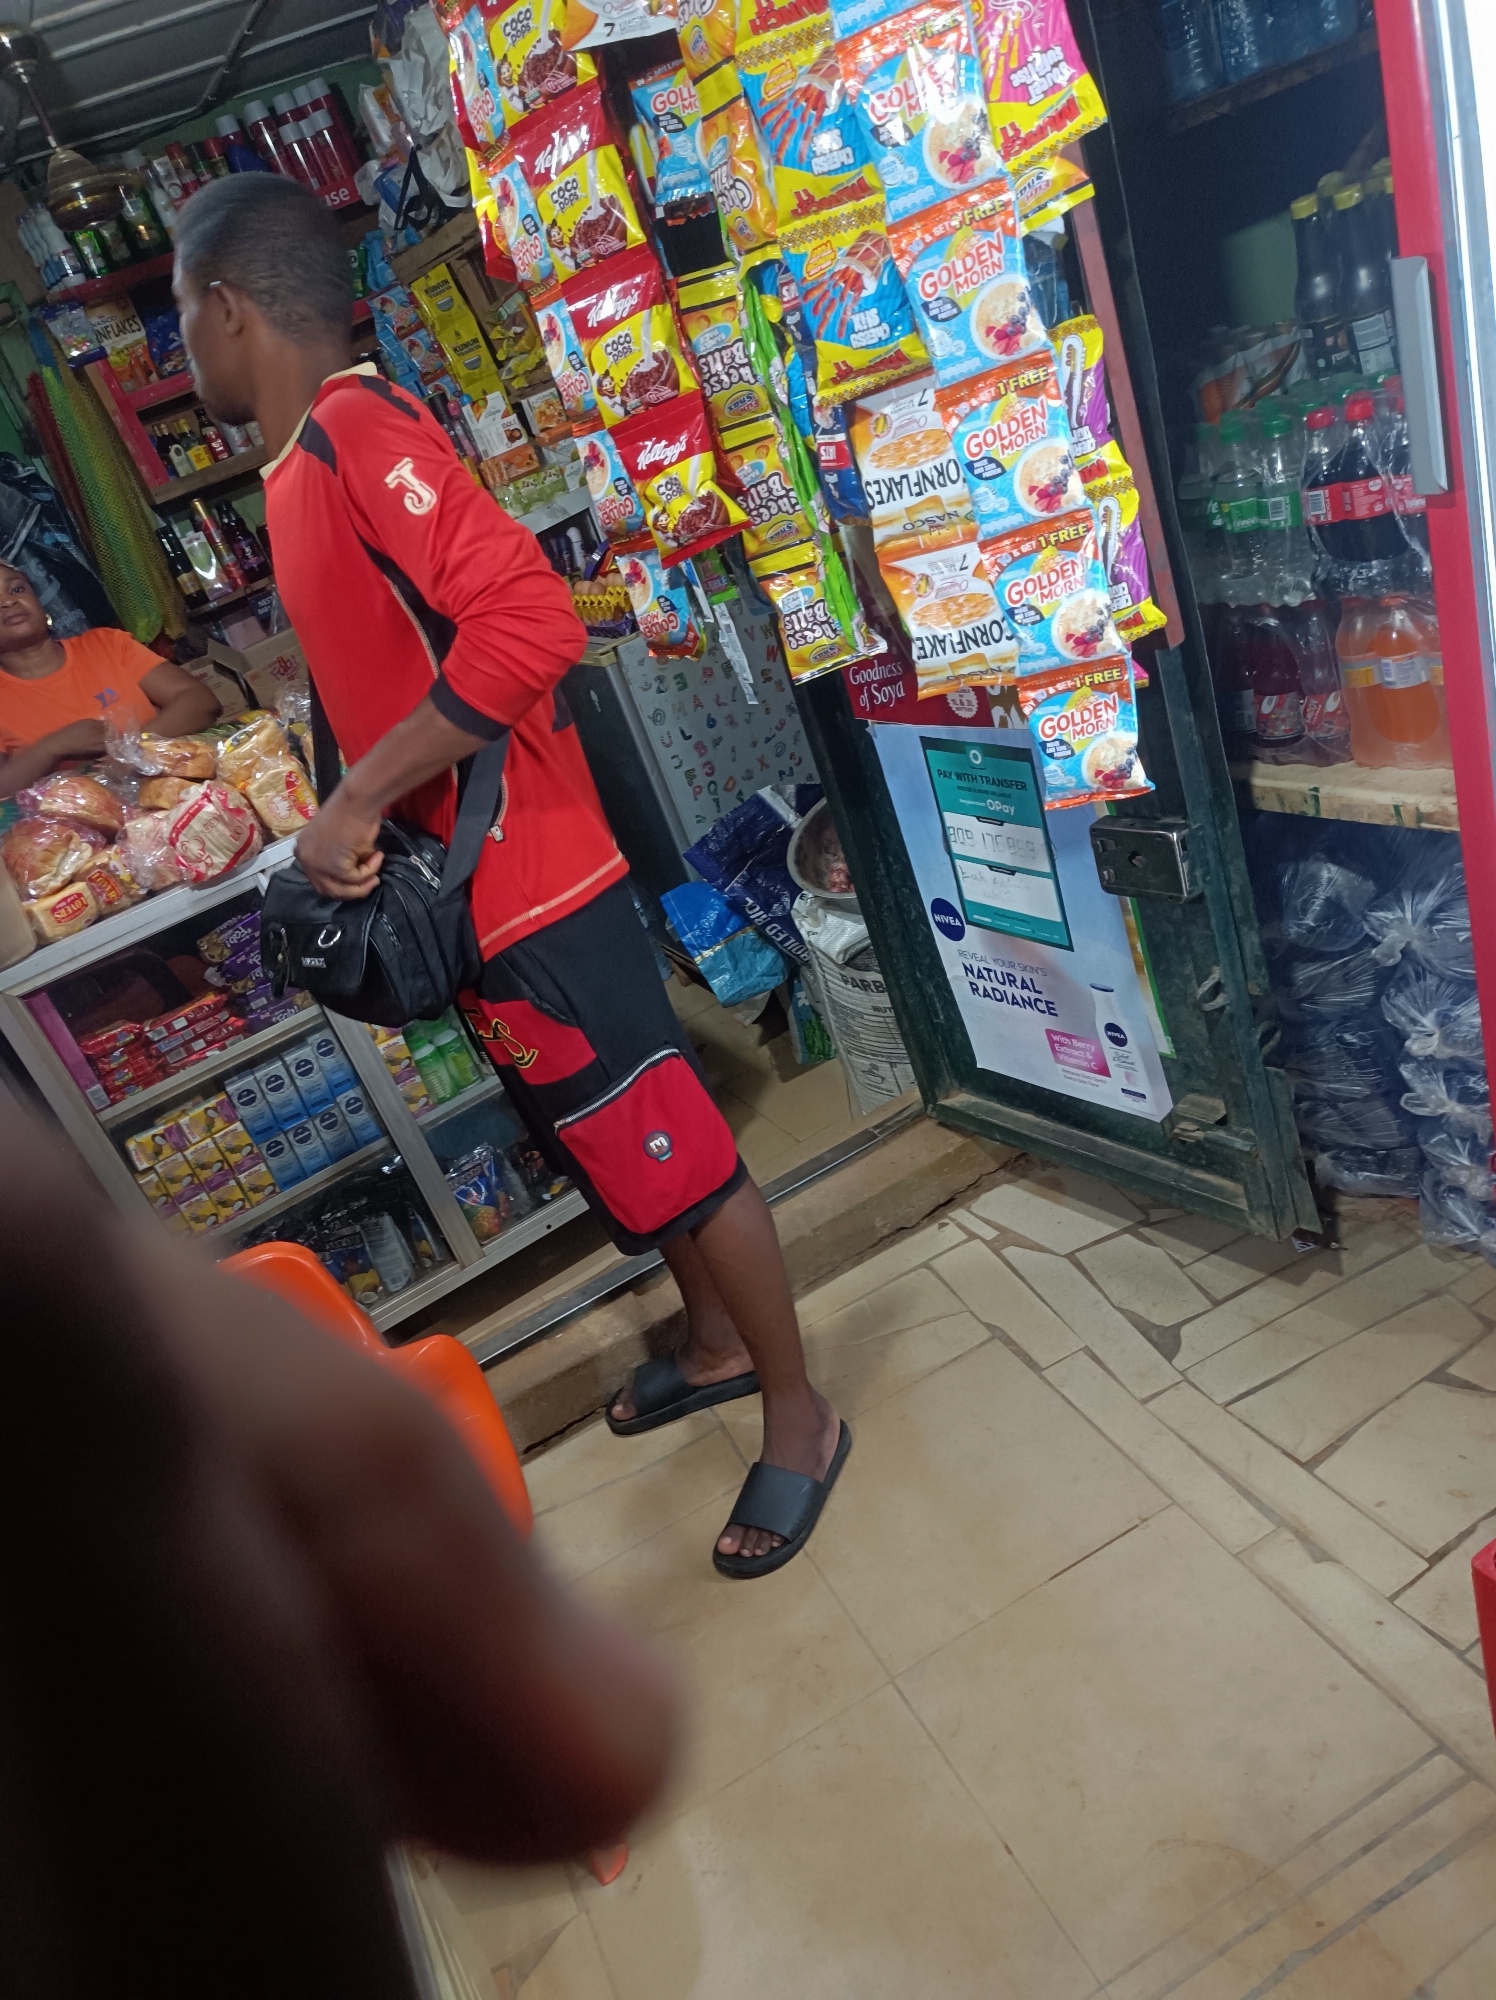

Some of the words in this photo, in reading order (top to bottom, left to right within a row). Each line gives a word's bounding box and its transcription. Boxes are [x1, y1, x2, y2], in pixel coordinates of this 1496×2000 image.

[503, 8, 532, 37] COCO
[603, 23, 615, 37] 7
[551, 178, 579, 205] COCO
[791, 176, 872, 220] MUNCH
[933, 222, 950, 236] GET
[963, 198, 1007, 225] FREE
[921, 229, 1003, 299] GOLDEN
[955, 257, 1003, 295] MORN
[587, 288, 640, 327] Keogg's
[452, 337, 480, 353] KUNUN
[604, 331, 632, 356] COCO
[700, 342, 748, 375] Balls
[703, 364, 755, 397] heese
[997, 381, 1007, 396] 1
[1009, 366, 1050, 391] FREE
[727, 392, 754, 412] Snax
[965, 399, 1047, 458] GOLDEN
[1001, 424, 1046, 456] MORN
[636, 436, 689, 471] Kellogg's
[738, 475, 786, 508] Balls
[865, 458, 962, 511] ORNFLAKES
[752, 490, 803, 525] Chees
[903, 509, 960, 531] NASCO
[988, 566, 1001, 581] BUY
[1013, 548, 1020, 557] &
[1020, 540, 1037, 552] GET
[1038, 535, 1047, 549] 1
[1050, 523, 1089, 546] FREE
[1007, 557, 1085, 606] GOLDEN
[1040, 575, 1084, 604] MORN
[784, 602, 828, 631] Balls
[788, 620, 836, 649] heese
[850, 660, 902, 685] Goodness
[859, 687, 870, 711] of
[871, 681, 906, 707] Soya
[1023, 699, 1037, 715] BUY
[1049, 685, 1056, 694] &
[1073, 676, 1082, 688] 1
[1084, 668, 1122, 687] FREE
[1040, 695, 1118, 739] GOLDEN
[1072, 714, 1115, 741] MORN
[937, 769, 953, 780] PAY
[955, 772, 978, 783] WITH
[979, 775, 1028, 791] TRANSFER
[934, 913, 962, 927] NIVEA
[958, 949, 989, 965] REVEAL
[992, 957, 1016, 970] YOUR
[841, 973, 887, 994] PARB
[962, 962, 1043, 994] NATURAL
[969, 981, 1059, 1017] RADIANCE
[1051, 1033, 1071, 1046] With
[1072, 1039, 1095, 1052] Berry
[1054, 1044, 1084, 1057] Extract
[1057, 1053, 1090, 1069] Vitamin
[1091, 1062, 1098, 1070] C
